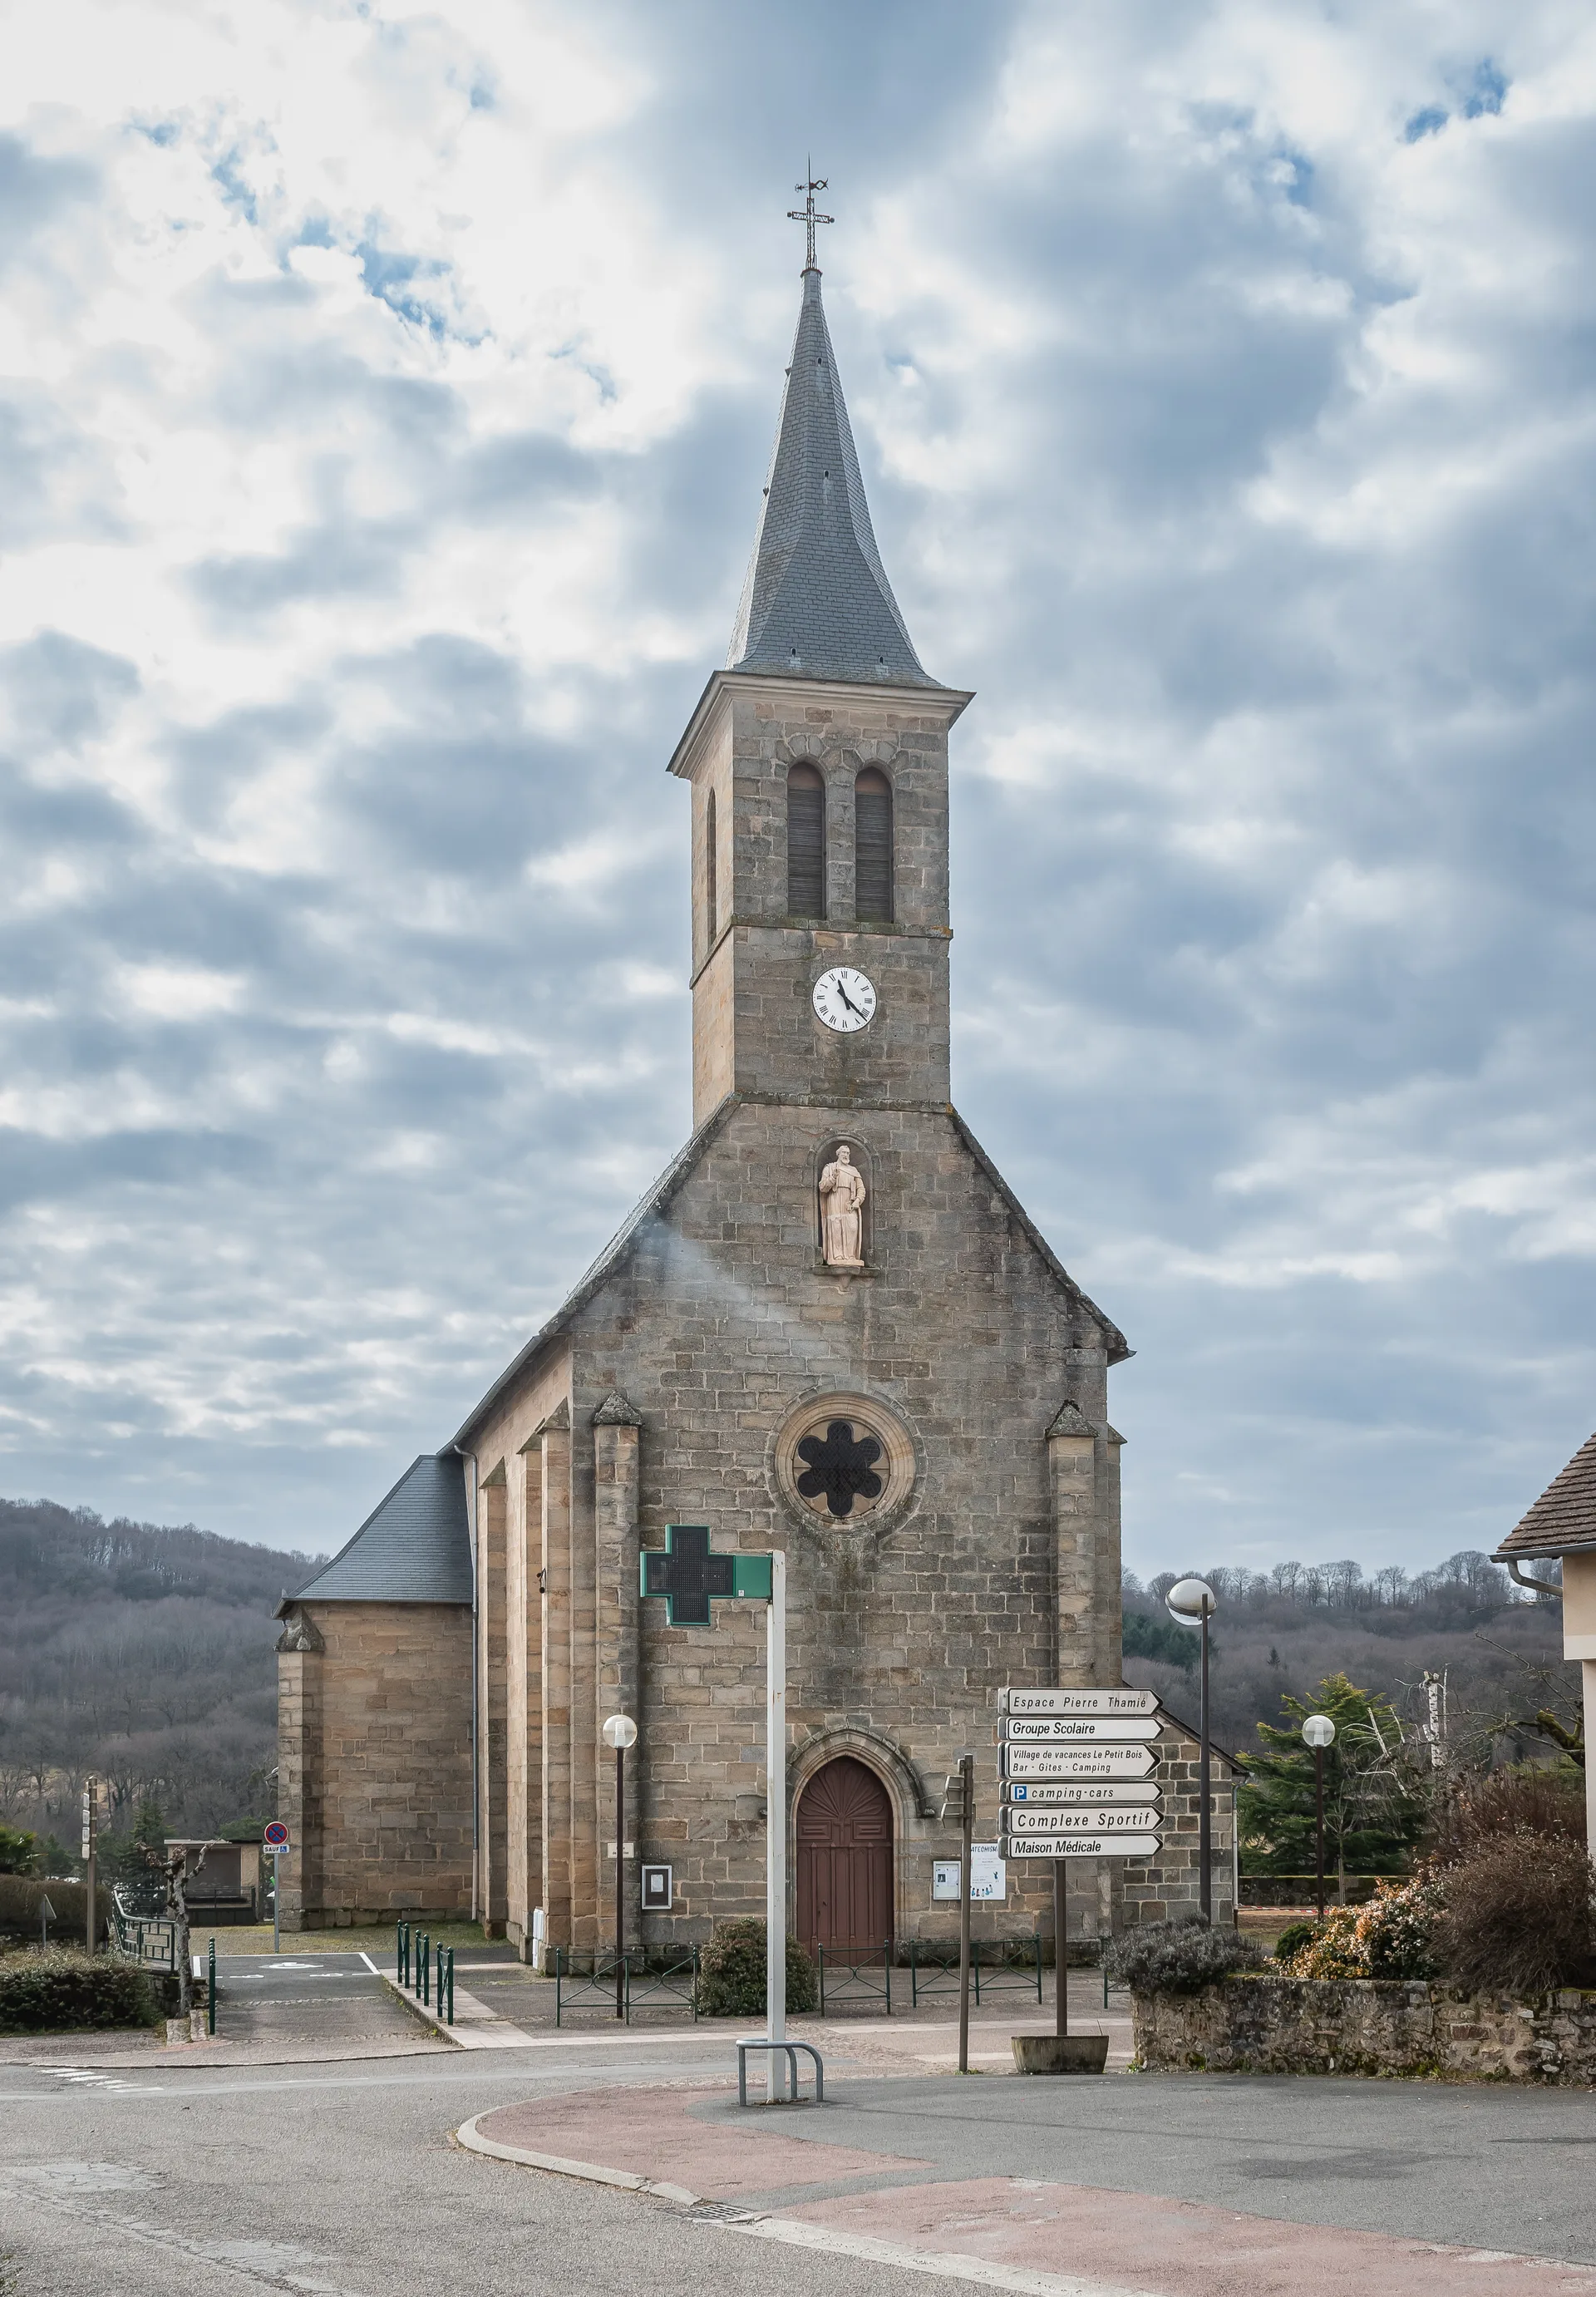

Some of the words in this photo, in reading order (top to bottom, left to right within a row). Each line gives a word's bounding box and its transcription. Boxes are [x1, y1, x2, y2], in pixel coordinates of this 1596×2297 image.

[1013, 1697, 1055, 1709] Espace
[1063, 1697, 1098, 1708] Pierre
[1108, 1697, 1146, 1708] Thamié
[1012, 1722, 1050, 1737] Groupe
[1053, 1722, 1096, 1734] Scolaire
[1013, 1750, 1040, 1761] Village
[1042, 1750, 1052, 1759] de
[1093, 1750, 1103, 1759] Le
[1104, 1750, 1123, 1759] Petit
[1126, 1750, 1143, 1759] Bois
[1012, 1763, 1028, 1772] Bar
[1072, 1763, 1111, 1773] Camping
[1017, 1787, 1025, 1798] P
[1032, 1789, 1114, 1800] camping-cars
[1017, 1814, 1089, 1829] Complexe
[1097, 1812, 1150, 1828] Sportif
[1015, 1841, 1052, 1853] Maison
[1055, 1841, 1101, 1853] Médicale
